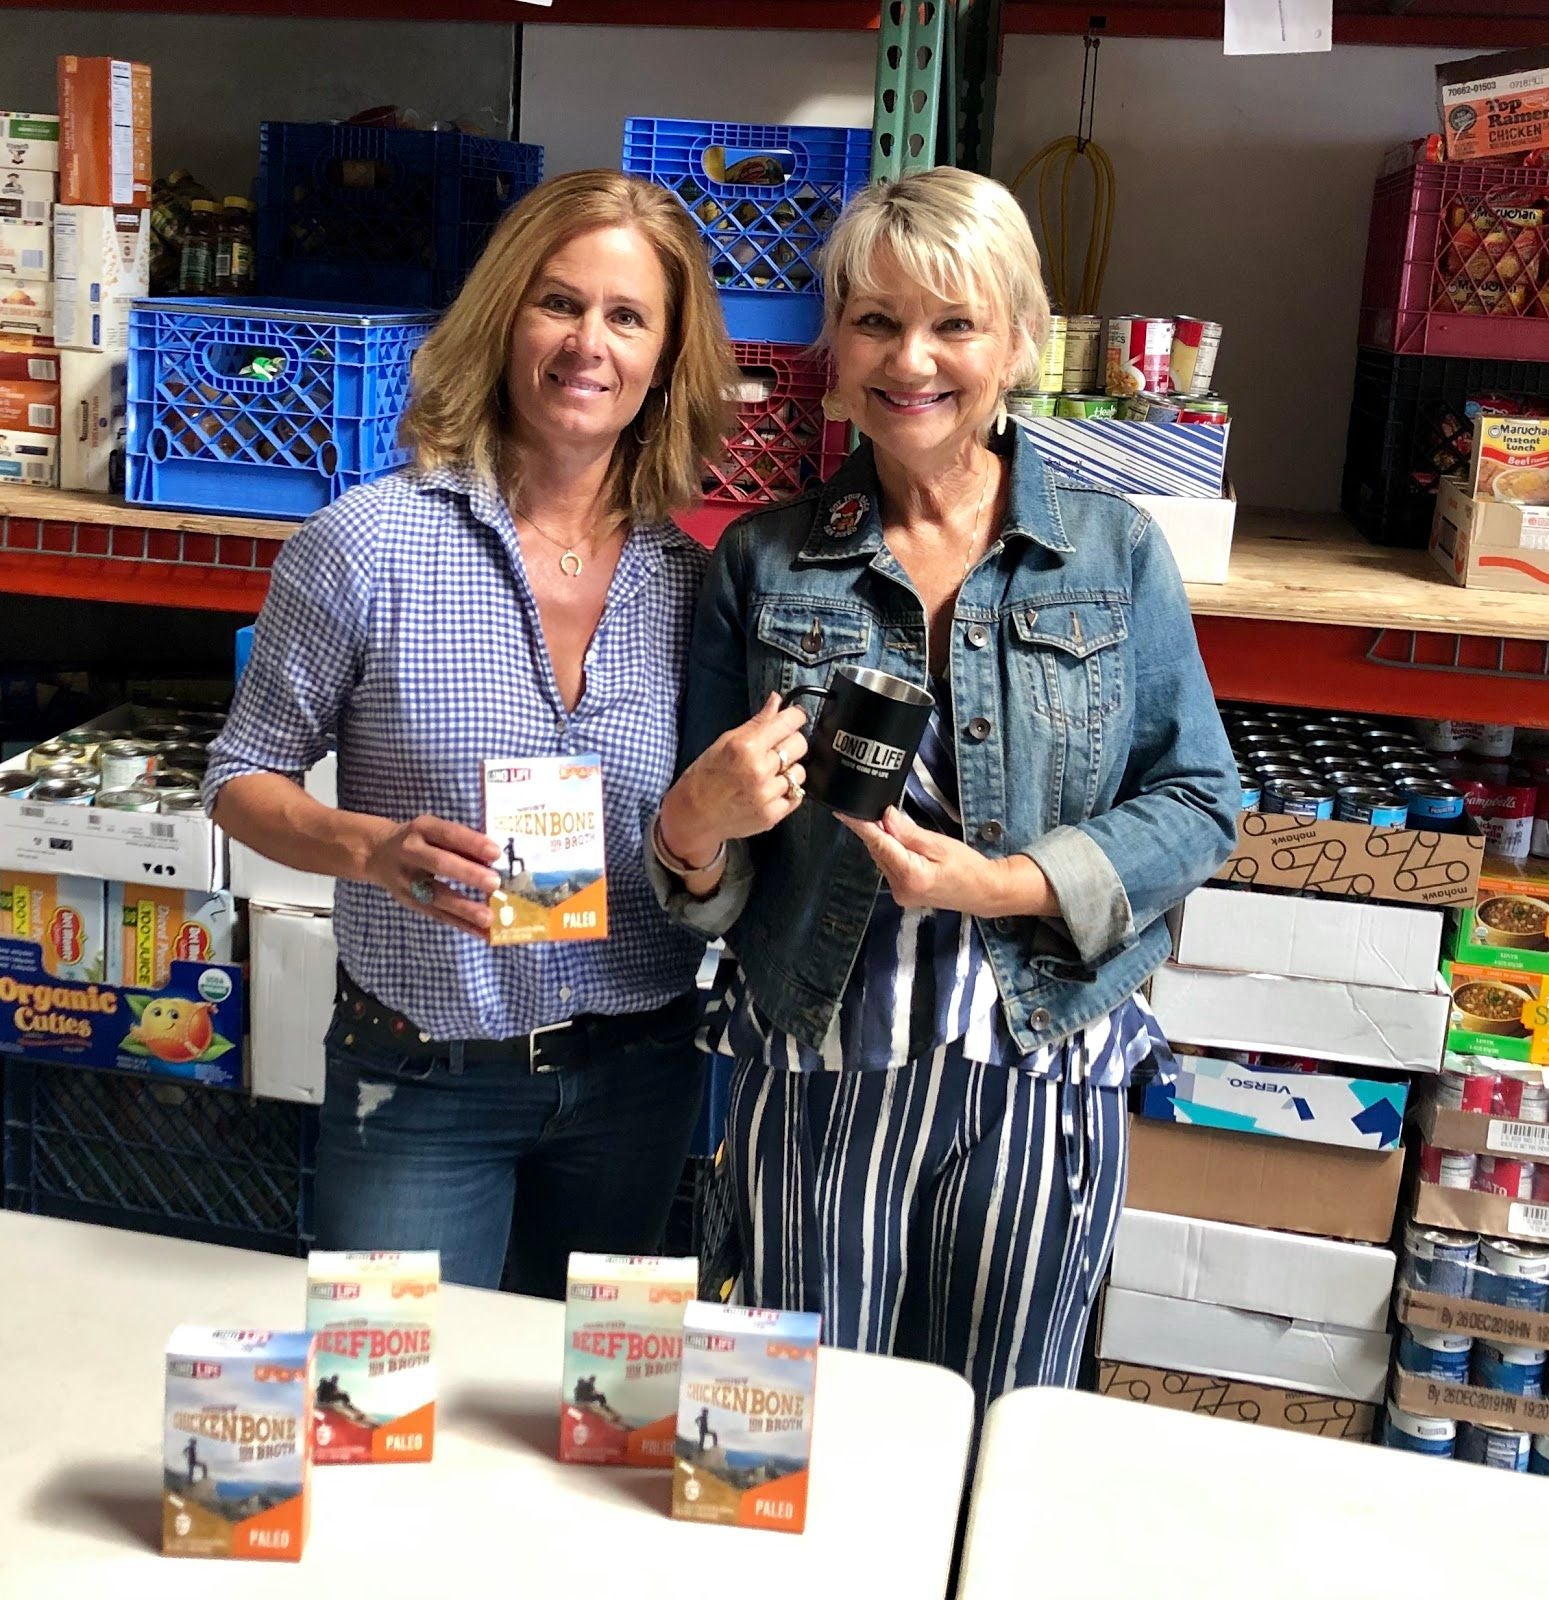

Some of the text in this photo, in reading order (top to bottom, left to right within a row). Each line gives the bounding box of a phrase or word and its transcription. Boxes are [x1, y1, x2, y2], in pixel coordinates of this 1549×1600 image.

[1485, 98, 1522, 114] Top
[1489, 123, 1542, 143] CHICKEN
[1500, 424, 1549, 437] Marucha
[1503, 435, 1541, 445] Instant
[1506, 442, 1537, 452] Lunch
[1508, 456, 1531, 466] Beef
[835, 732, 869, 760] LONO
[871, 745, 904, 768] LIFE
[1270, 829, 1317, 846] mohawk
[1422, 886, 1468, 902] mohawk
[563, 911, 597, 928] PALEO
[0, 977, 118, 1013] Organic
[14, 1006, 92, 1038] Cuties
[1441, 1307, 1454, 1328] By
[644, 1361, 682, 1378] BROT
[1427, 1384, 1440, 1405] By
[765, 1417, 803, 1432] BROTH
[385, 1433, 423, 1451] PALEO
[755, 1499, 793, 1521] PALEO
[249, 1529, 290, 1549] PALEO
